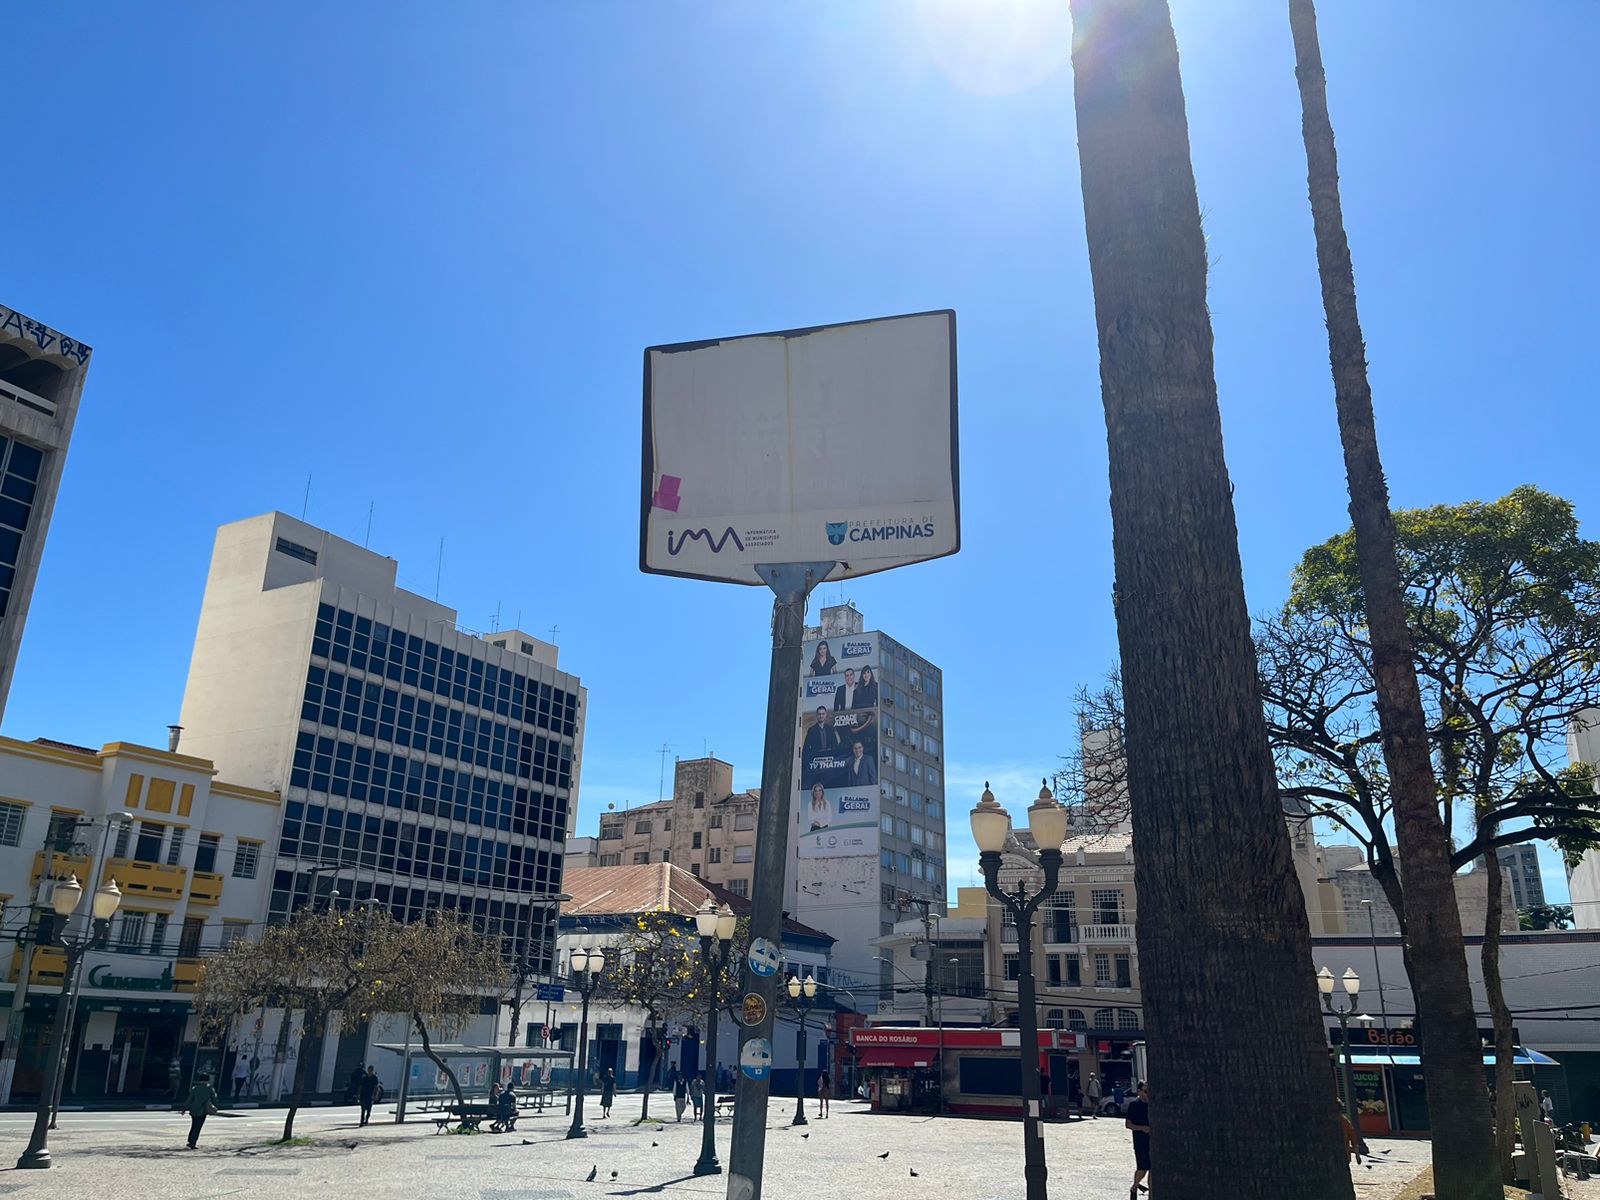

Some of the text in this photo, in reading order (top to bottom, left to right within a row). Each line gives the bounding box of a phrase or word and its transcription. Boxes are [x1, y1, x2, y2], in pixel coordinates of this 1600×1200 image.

[849, 515, 934, 527] PREFEITURA DE
[849, 523, 935, 542] CAMPINAS
[846, 647, 870, 655] GERAL
[811, 686, 835, 694] GERAL
[833, 719, 858, 727] ALERTA
[844, 802, 869, 810] GERAL
[889, 1035, 918, 1043] ROSÁRIO
[1368, 1029, 1415, 1045] Barão
